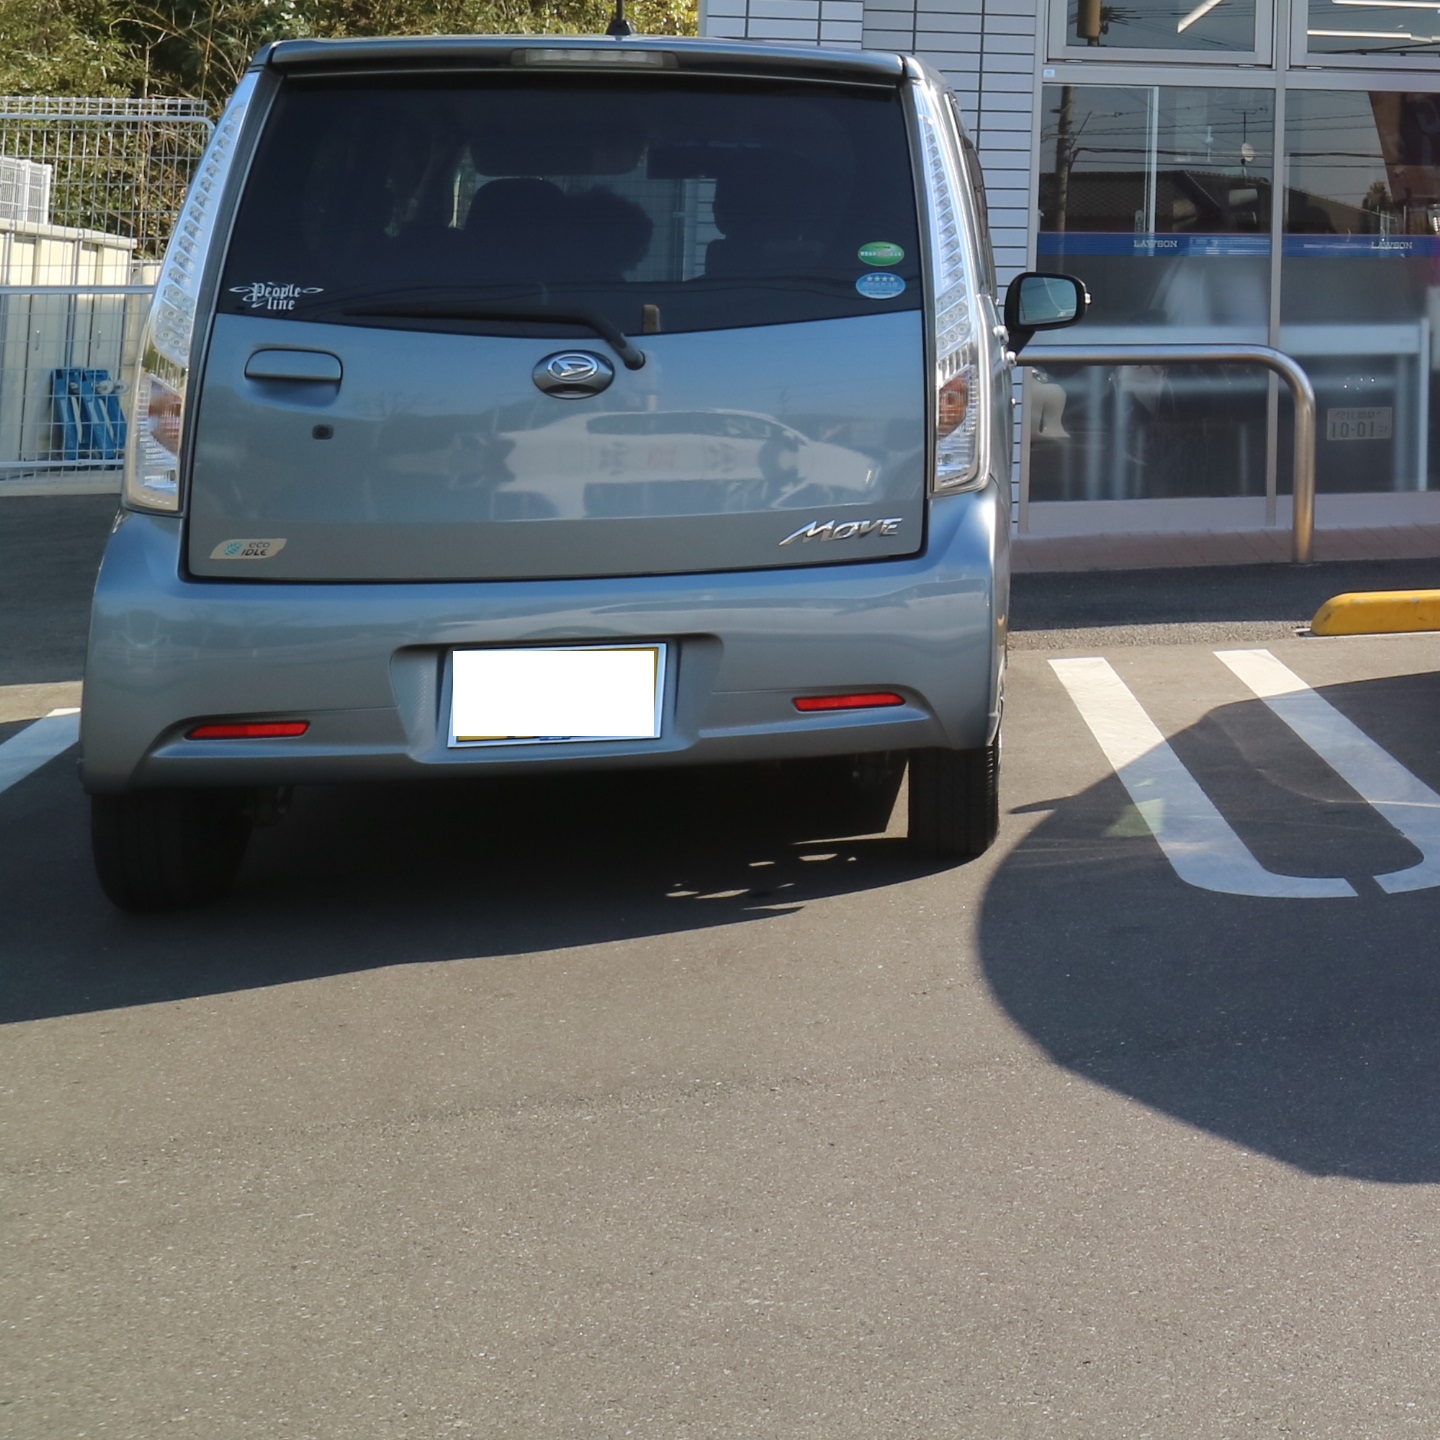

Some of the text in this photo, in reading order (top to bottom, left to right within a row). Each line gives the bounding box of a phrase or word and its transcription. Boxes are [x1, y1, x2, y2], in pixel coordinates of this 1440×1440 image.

[251, 282, 301, 301] People
[267, 296, 296, 310] line
[778, 517, 903, 546] MOVE
[248, 541, 271, 549] eco
[240, 548, 268, 557] IDLE
